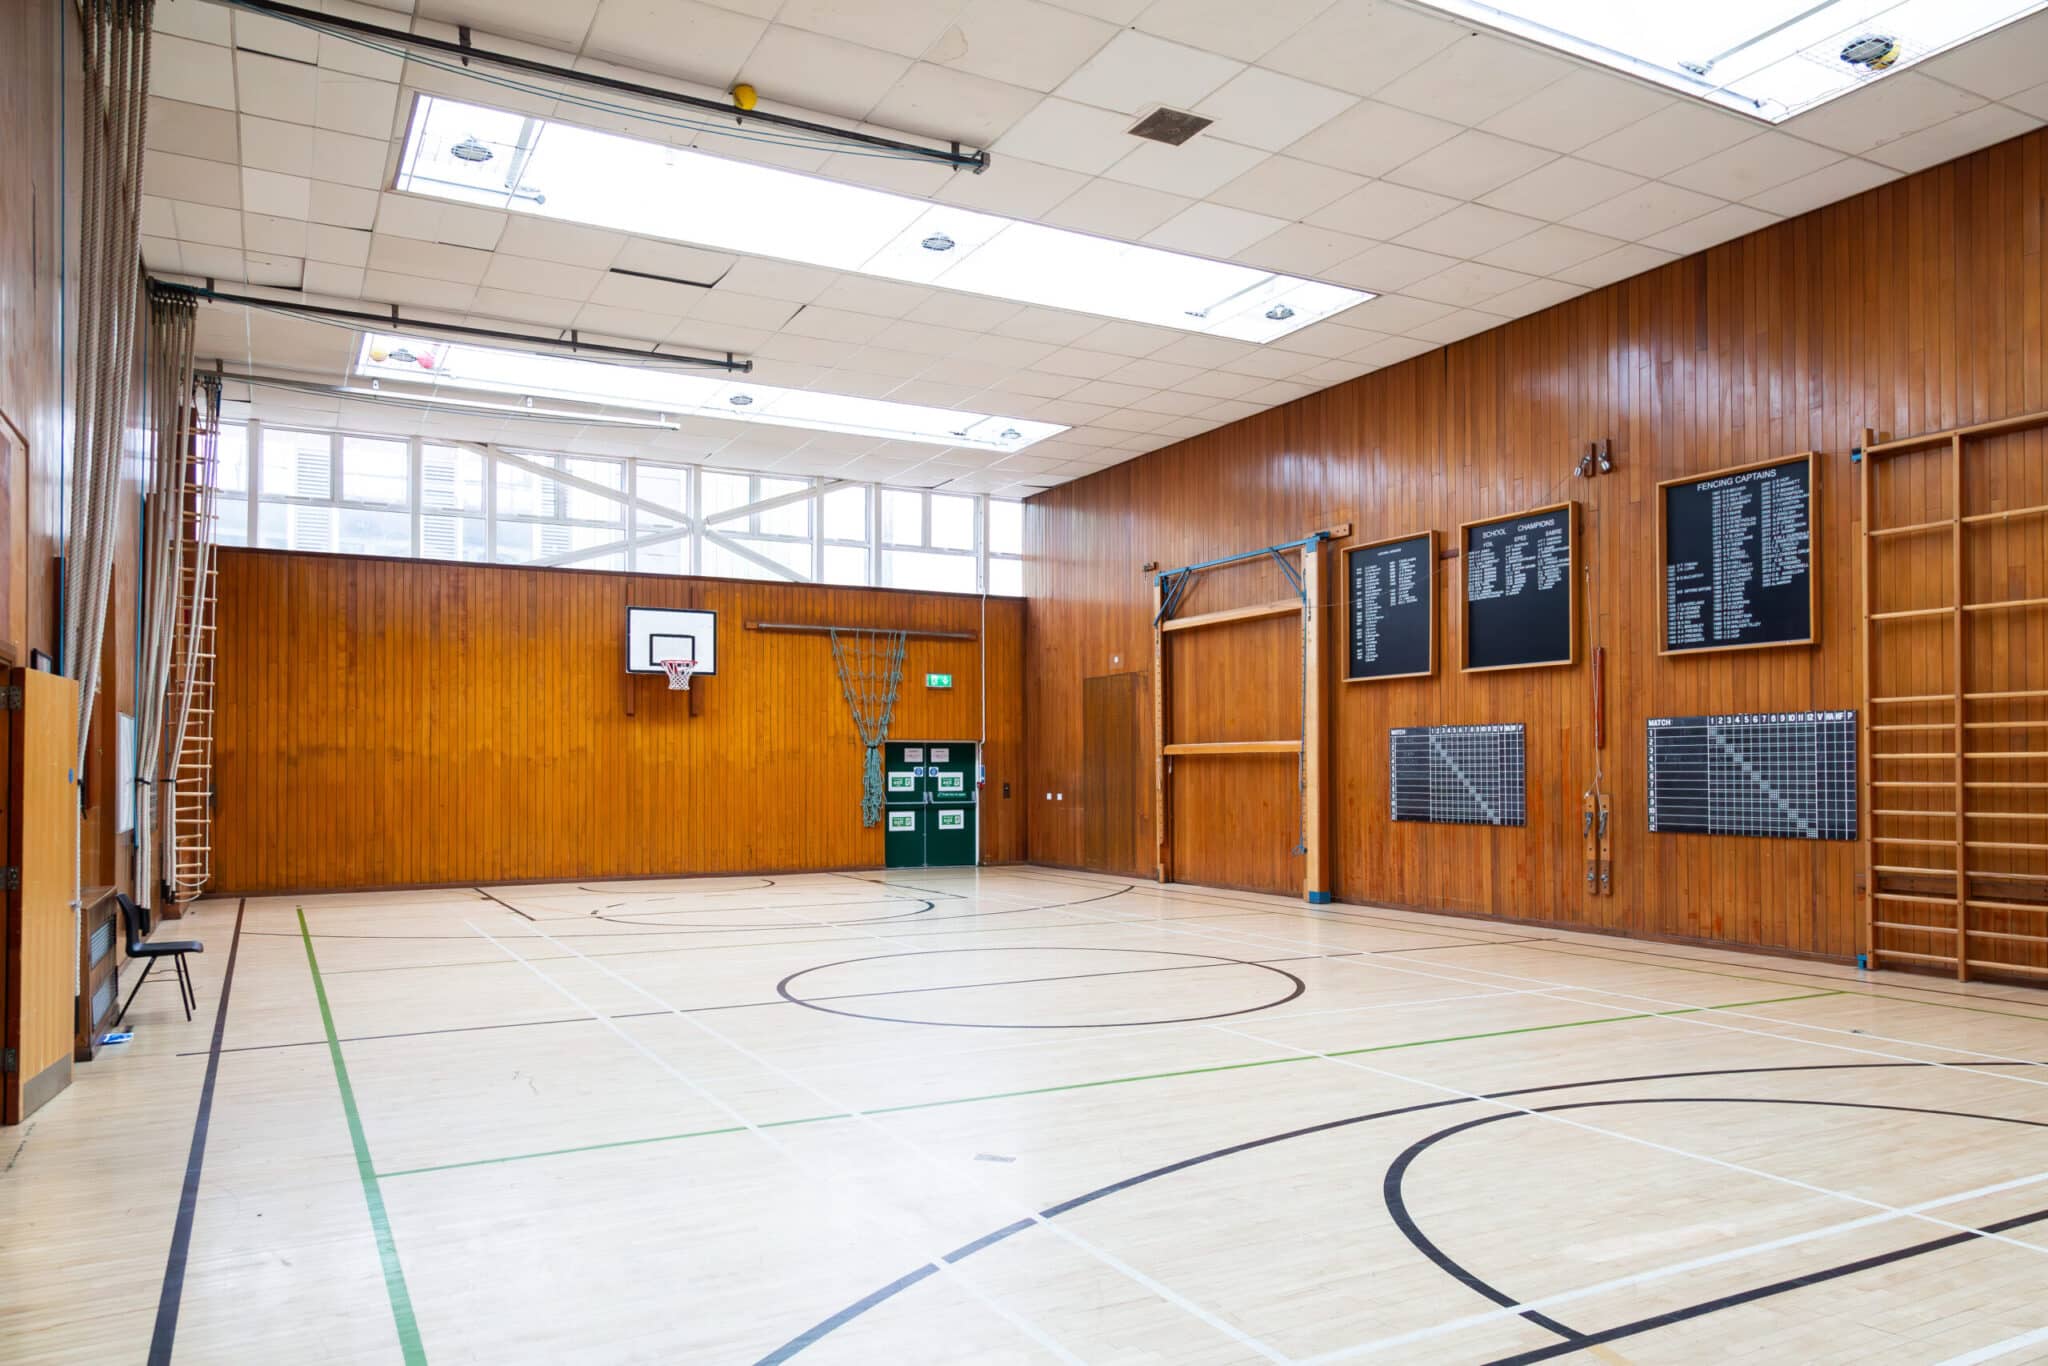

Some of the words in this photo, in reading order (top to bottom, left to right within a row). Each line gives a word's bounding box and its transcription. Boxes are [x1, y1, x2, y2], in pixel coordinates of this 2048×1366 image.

[1697, 477, 1733, 492] FENCING
[1735, 469, 1777, 484] CAPTAINS
[1482, 528, 1506, 539] SCHOOL
[1517, 518, 1554, 532] CHAMPIONS
[1648, 719, 1671, 727] MATCH
